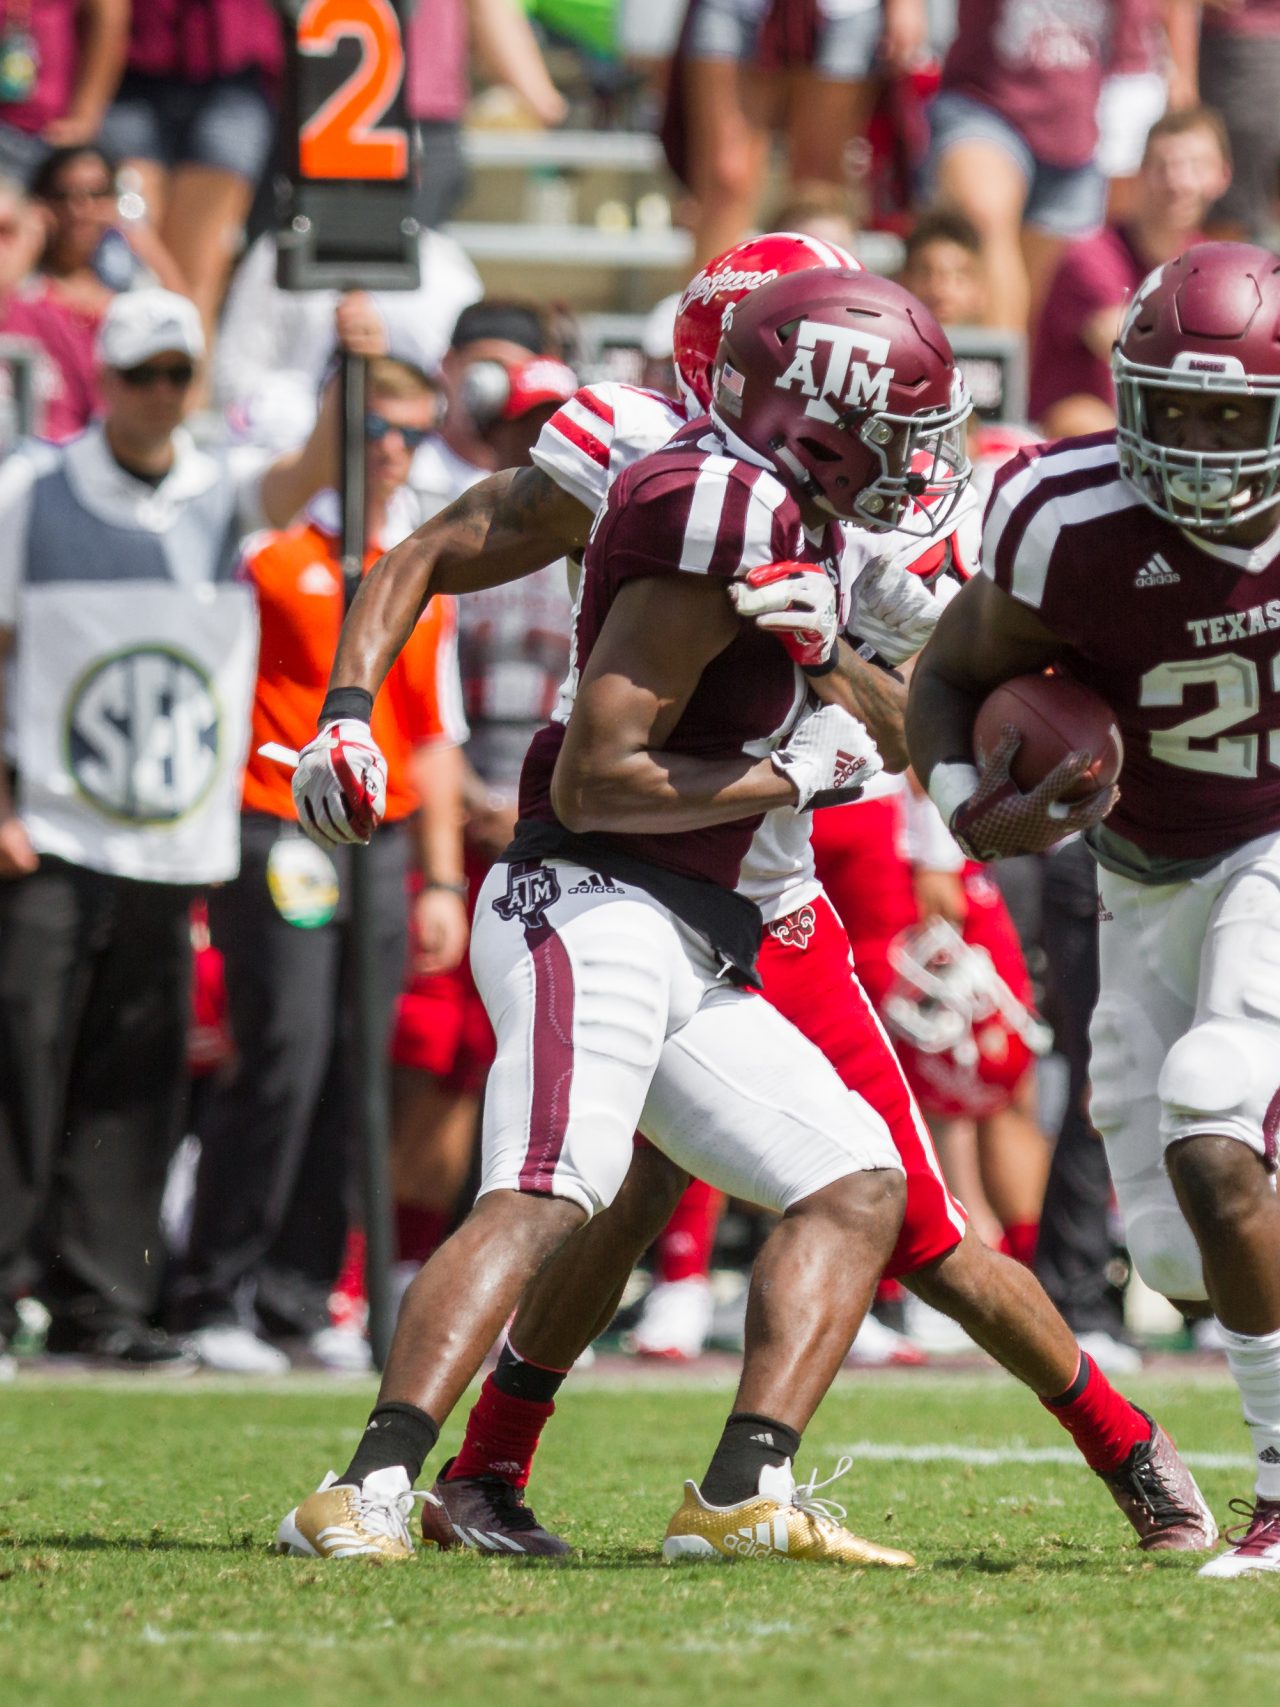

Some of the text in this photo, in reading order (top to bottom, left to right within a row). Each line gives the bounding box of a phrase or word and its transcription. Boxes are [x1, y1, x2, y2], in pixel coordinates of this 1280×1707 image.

[297, 0, 409, 180] 2
[1135, 571, 1181, 587] adidas
[72, 653, 218, 816] SEC
[833, 756, 867, 789] adidas
[567, 884, 626, 895] adidas
